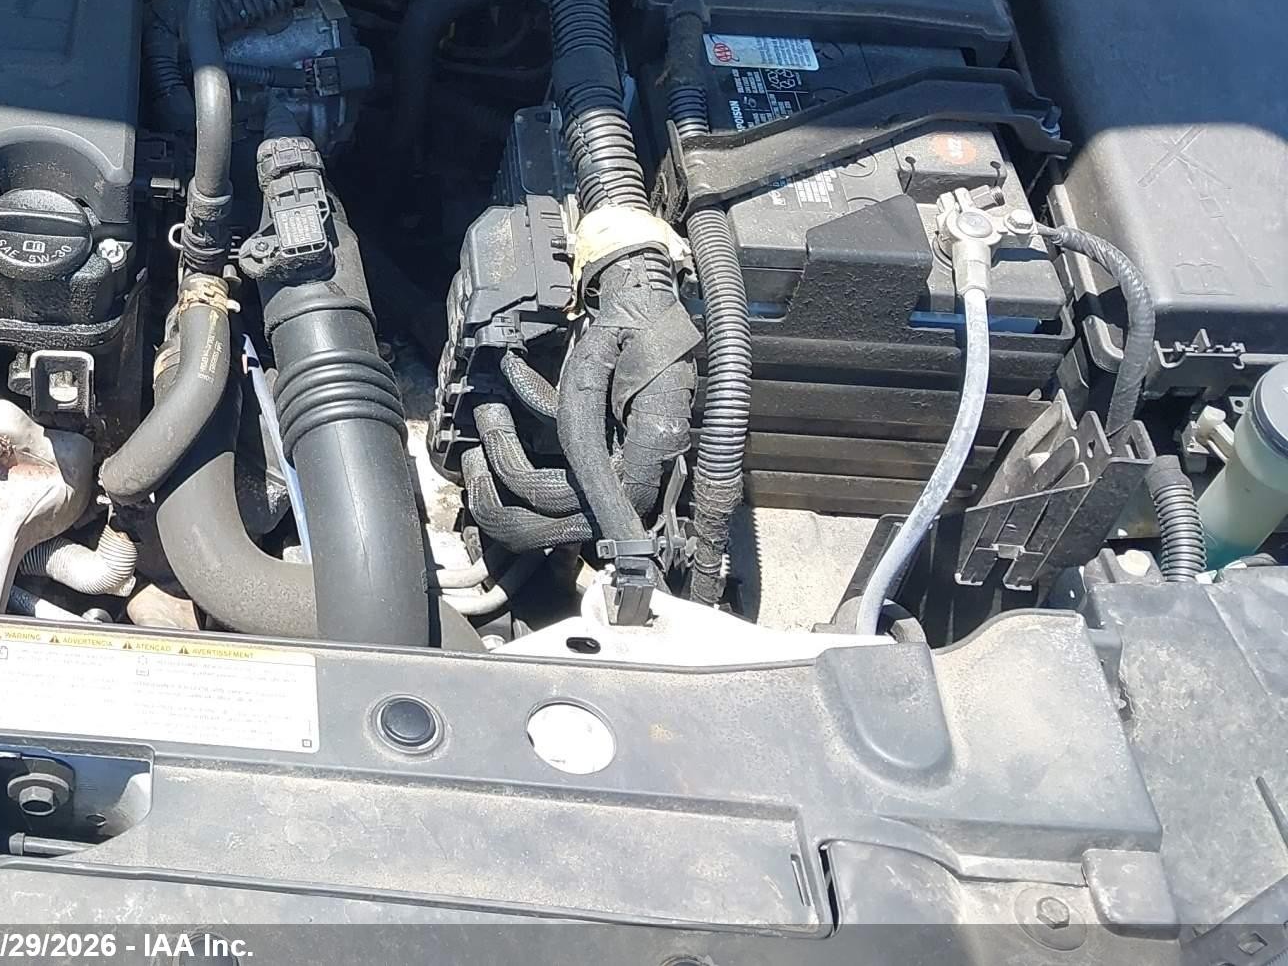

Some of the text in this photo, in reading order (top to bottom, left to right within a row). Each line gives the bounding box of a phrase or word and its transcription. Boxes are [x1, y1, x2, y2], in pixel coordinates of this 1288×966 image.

[28, 245, 72, 263] 5W-30
[4, 631, 42, 641] WARNING
[62, 636, 113, 647] ADVERTENCIA
[192, 647, 255, 659] AVERTISSEMENT
